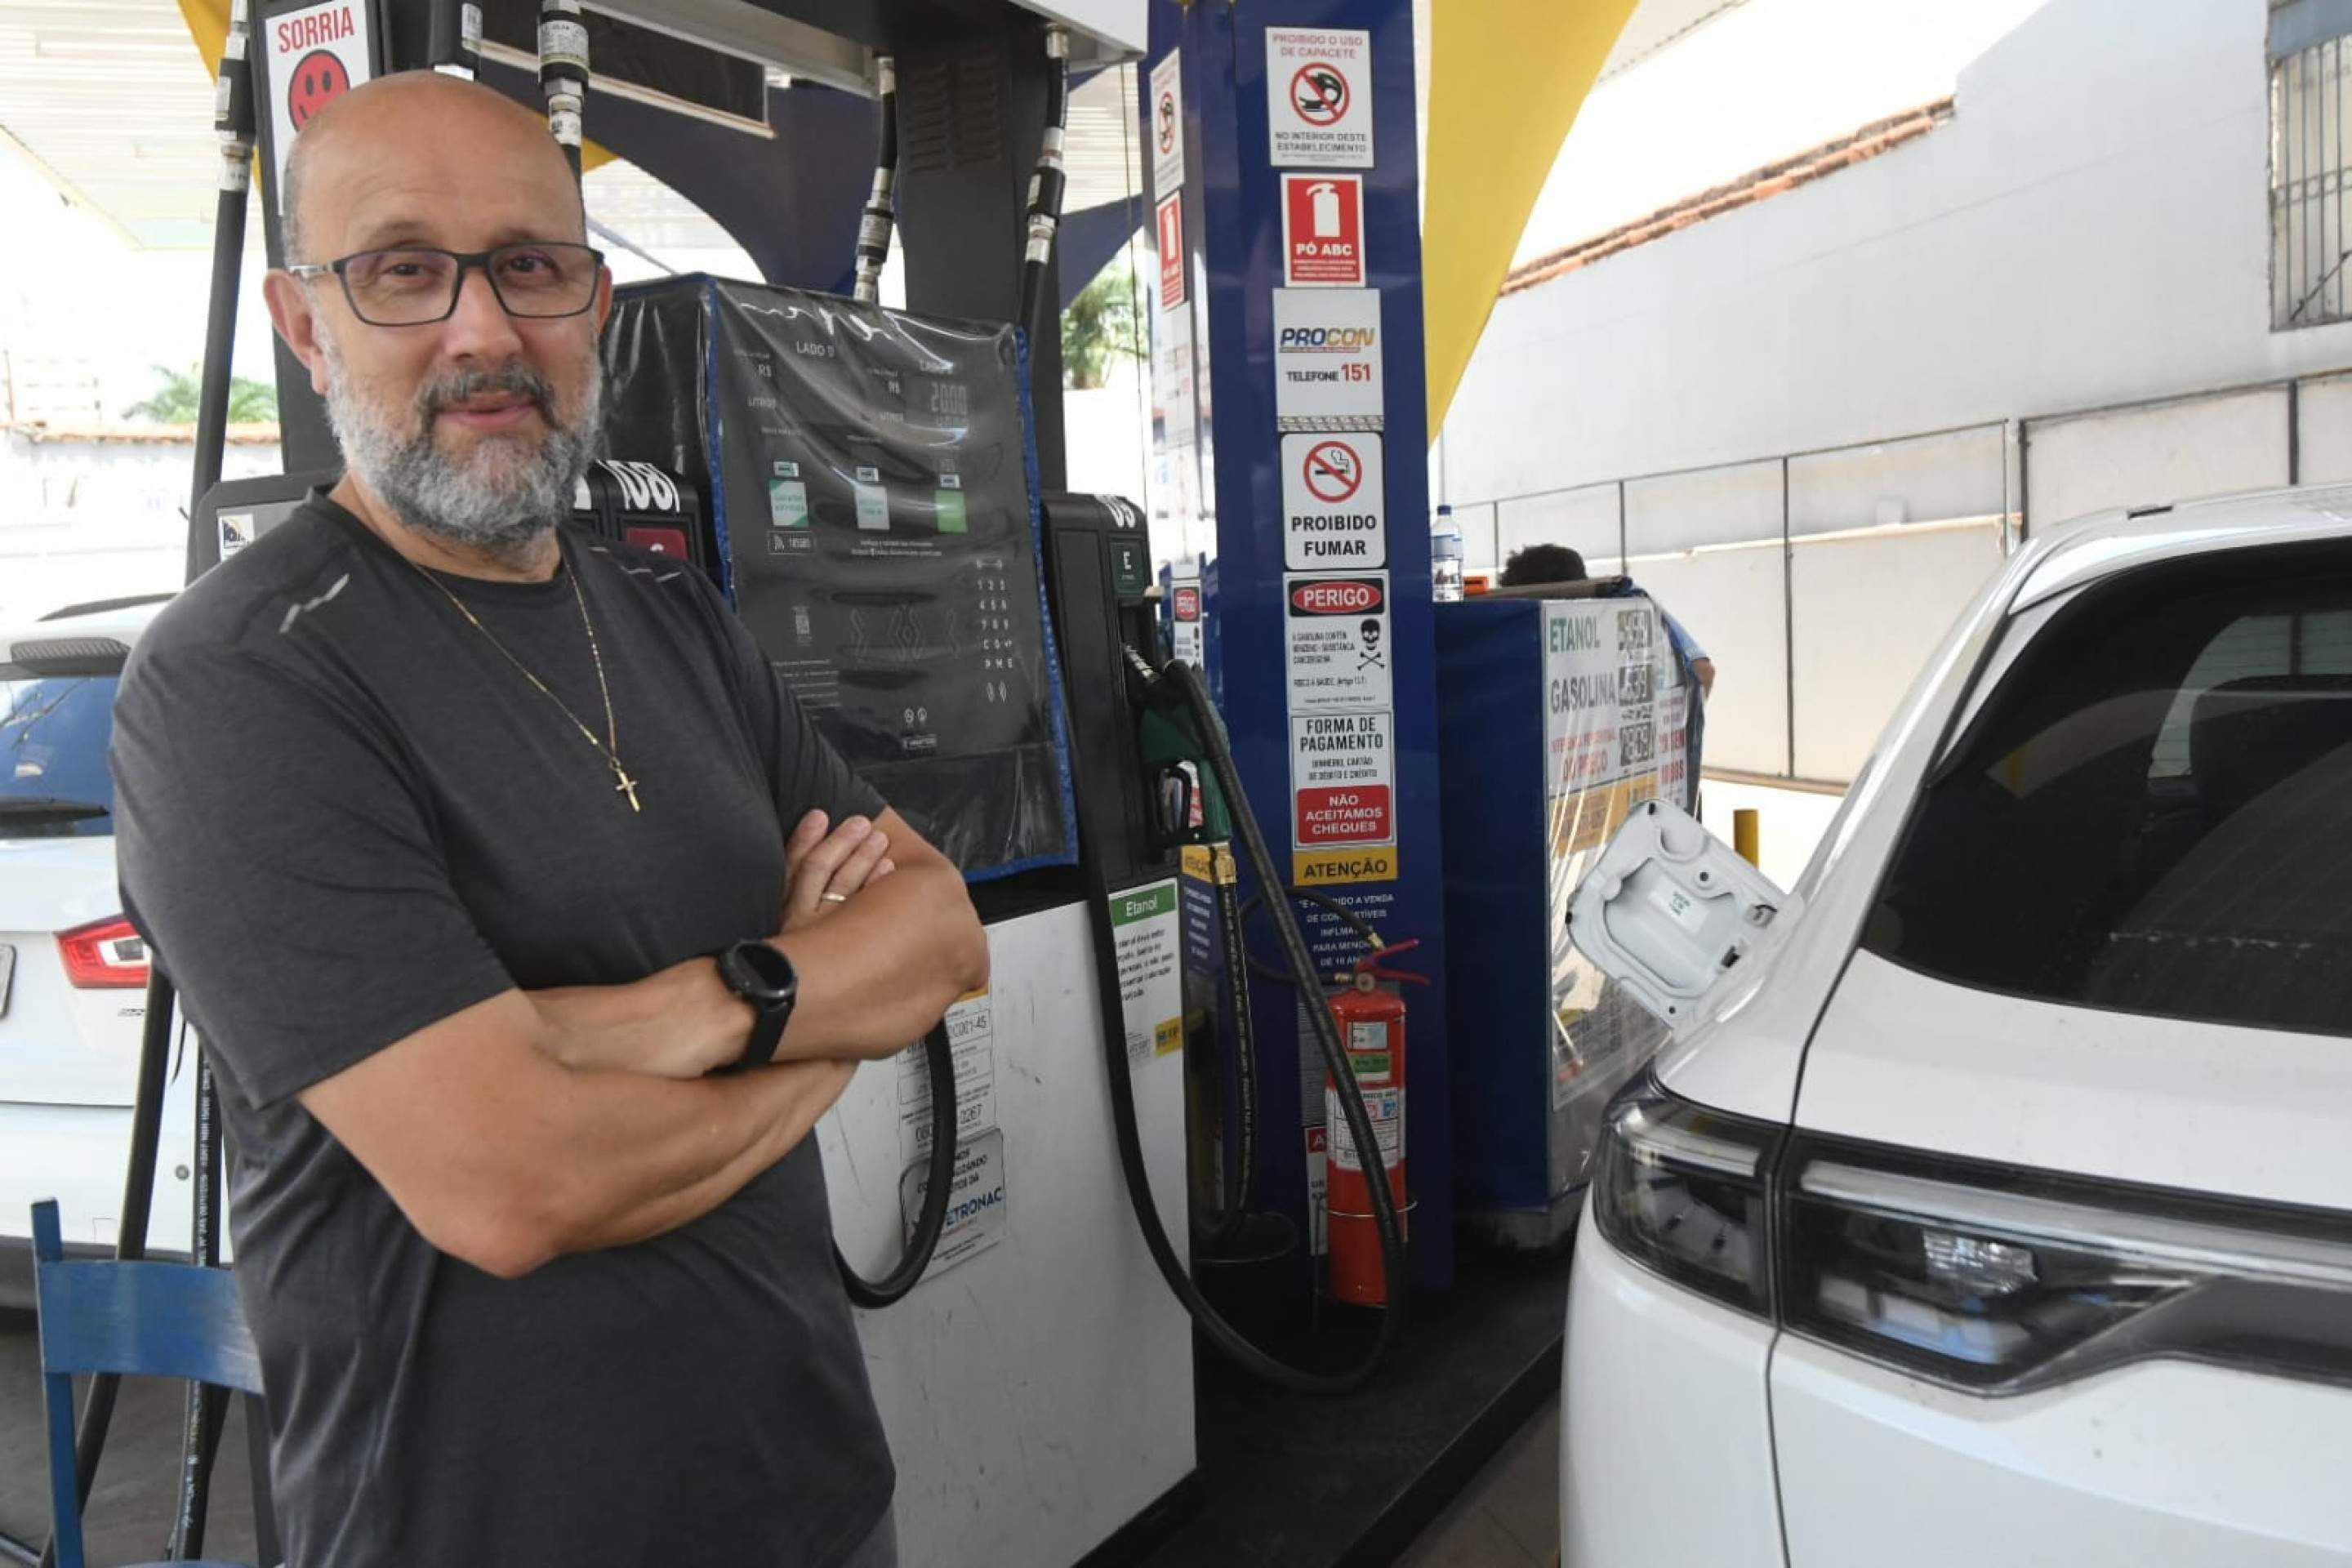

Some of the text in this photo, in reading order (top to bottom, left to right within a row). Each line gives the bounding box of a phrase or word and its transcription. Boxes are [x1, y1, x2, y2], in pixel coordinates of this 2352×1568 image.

[278, 7, 355, 53] SORRIA
[1272, 33, 1363, 46] PROIBIDO O USO
[1281, 47, 1356, 59] DE CAPACETE
[1276, 131, 1367, 142] NO INTERIOR DESTE
[1277, 142, 1366, 152] ESTABELECIMENTO
[1296, 240, 1353, 256] PÓ ABC
[1280, 327, 1375, 346] PROCON
[1287, 362, 1371, 382] TELEFONE 151
[1291, 514, 1377, 532] PROIBIDO
[1303, 540, 1367, 557] FUMAR
[1123, 551, 1132, 570] E
[1303, 587, 1370, 608] PERIGO
[1549, 616, 1601, 653] ETANOL
[1551, 671, 1617, 715] GASOLINA
[1307, 716, 1377, 735] FORMA DE
[1299, 733, 1384, 752] PAGAMENTO
[1329, 794, 1359, 806] NÃO
[1306, 807, 1383, 822] ACEITAMOS
[1312, 821, 1377, 835] CHEQUES
[1303, 858, 1388, 878] ATENÇÃO
[1125, 895, 1158, 917] Etanol
[1365, 894, 1395, 904] VENDA
[1313, 942, 1338, 952] PARA
